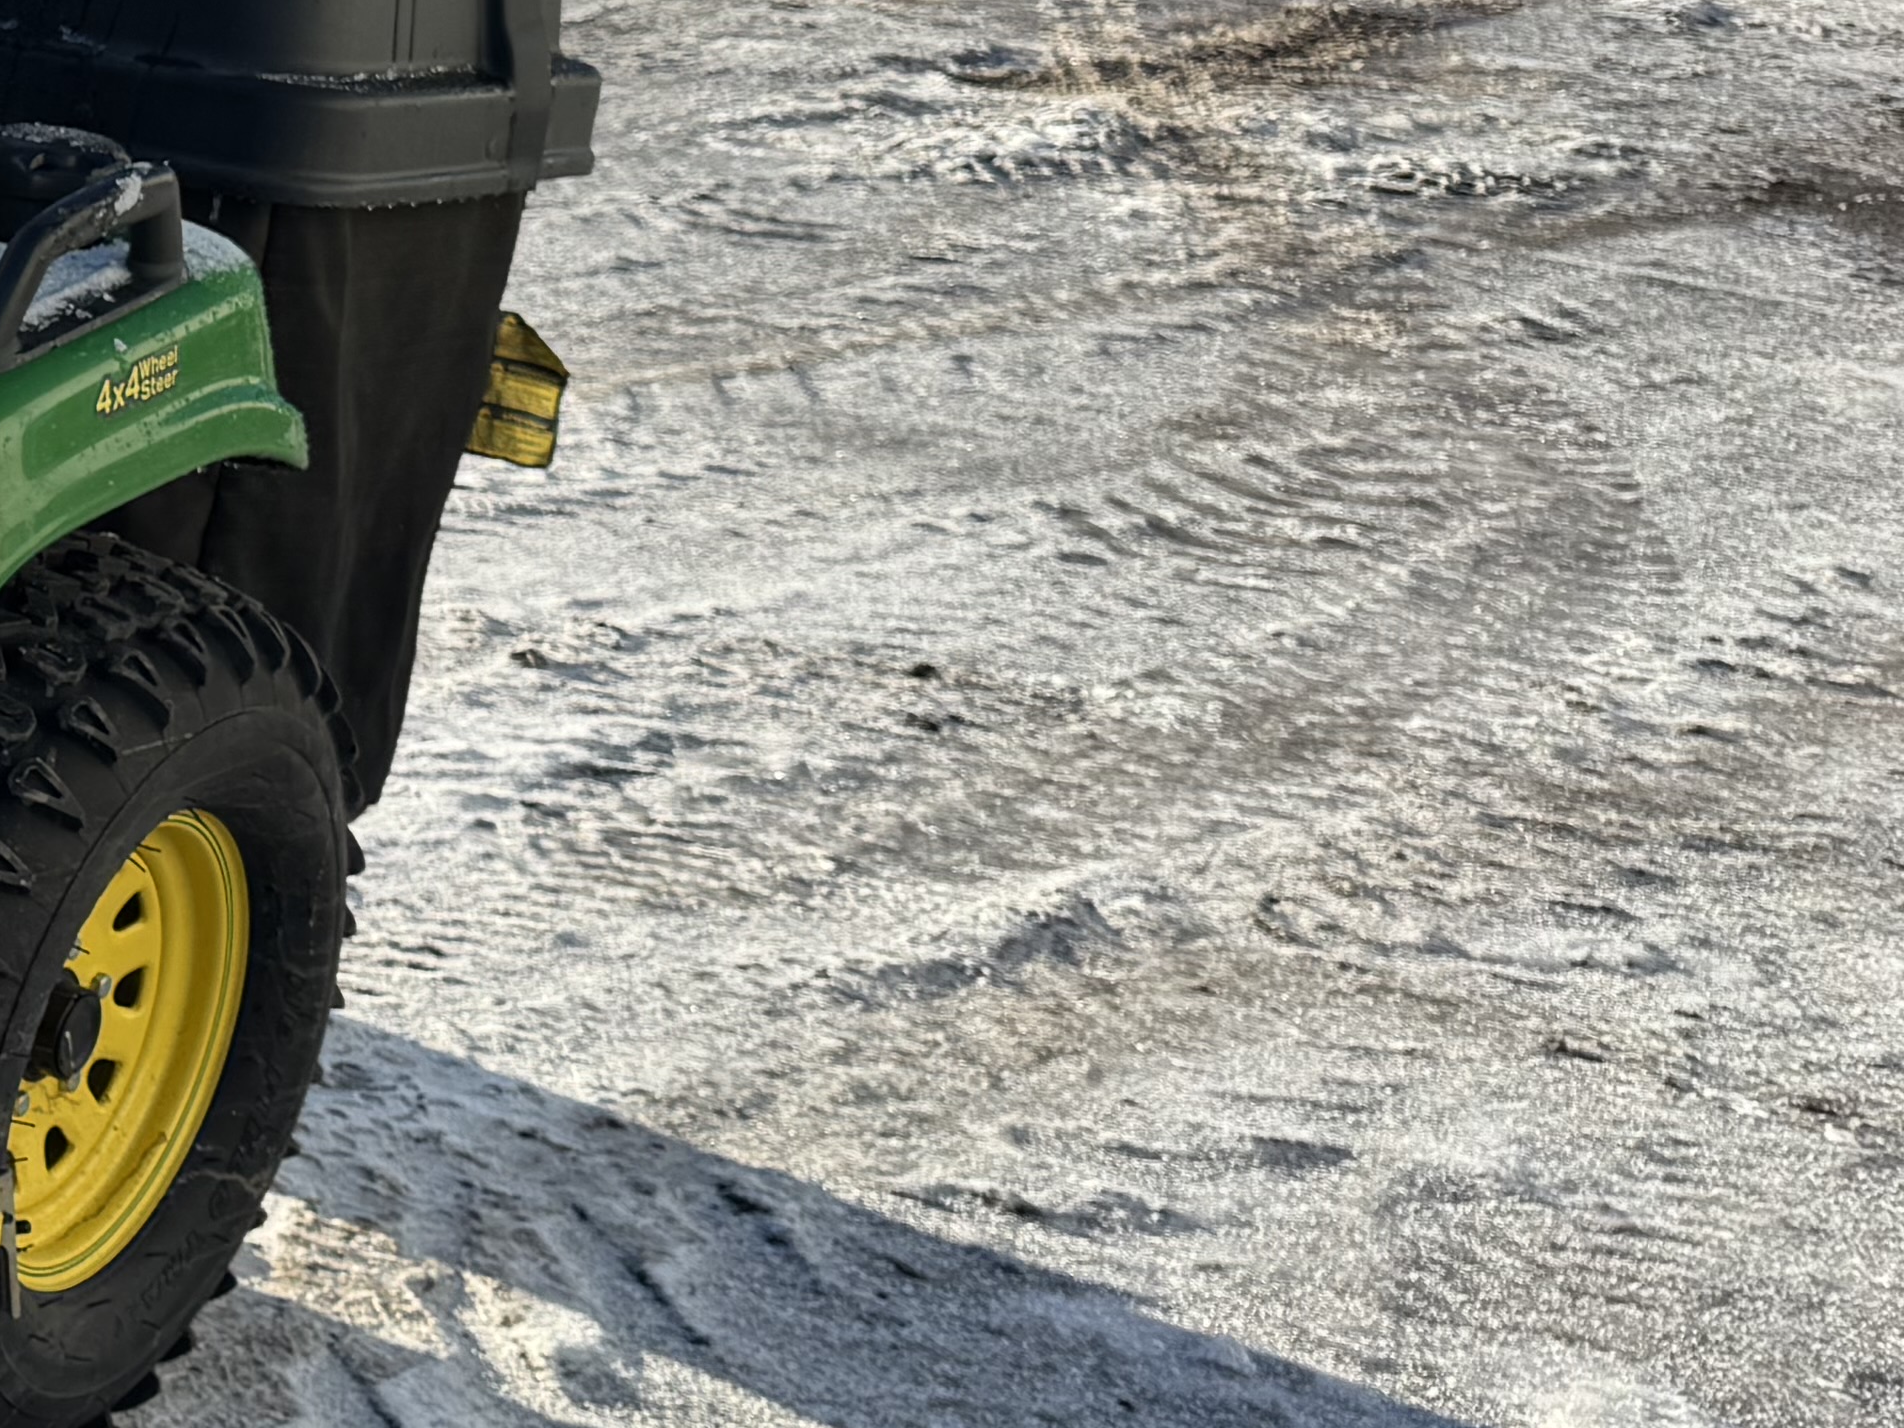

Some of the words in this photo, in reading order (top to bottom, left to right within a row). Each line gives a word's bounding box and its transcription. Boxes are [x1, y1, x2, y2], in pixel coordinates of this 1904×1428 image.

[138, 344, 179, 380] Wheel
[95, 364, 141, 415] 4x4
[140, 369, 180, 401] Steer
